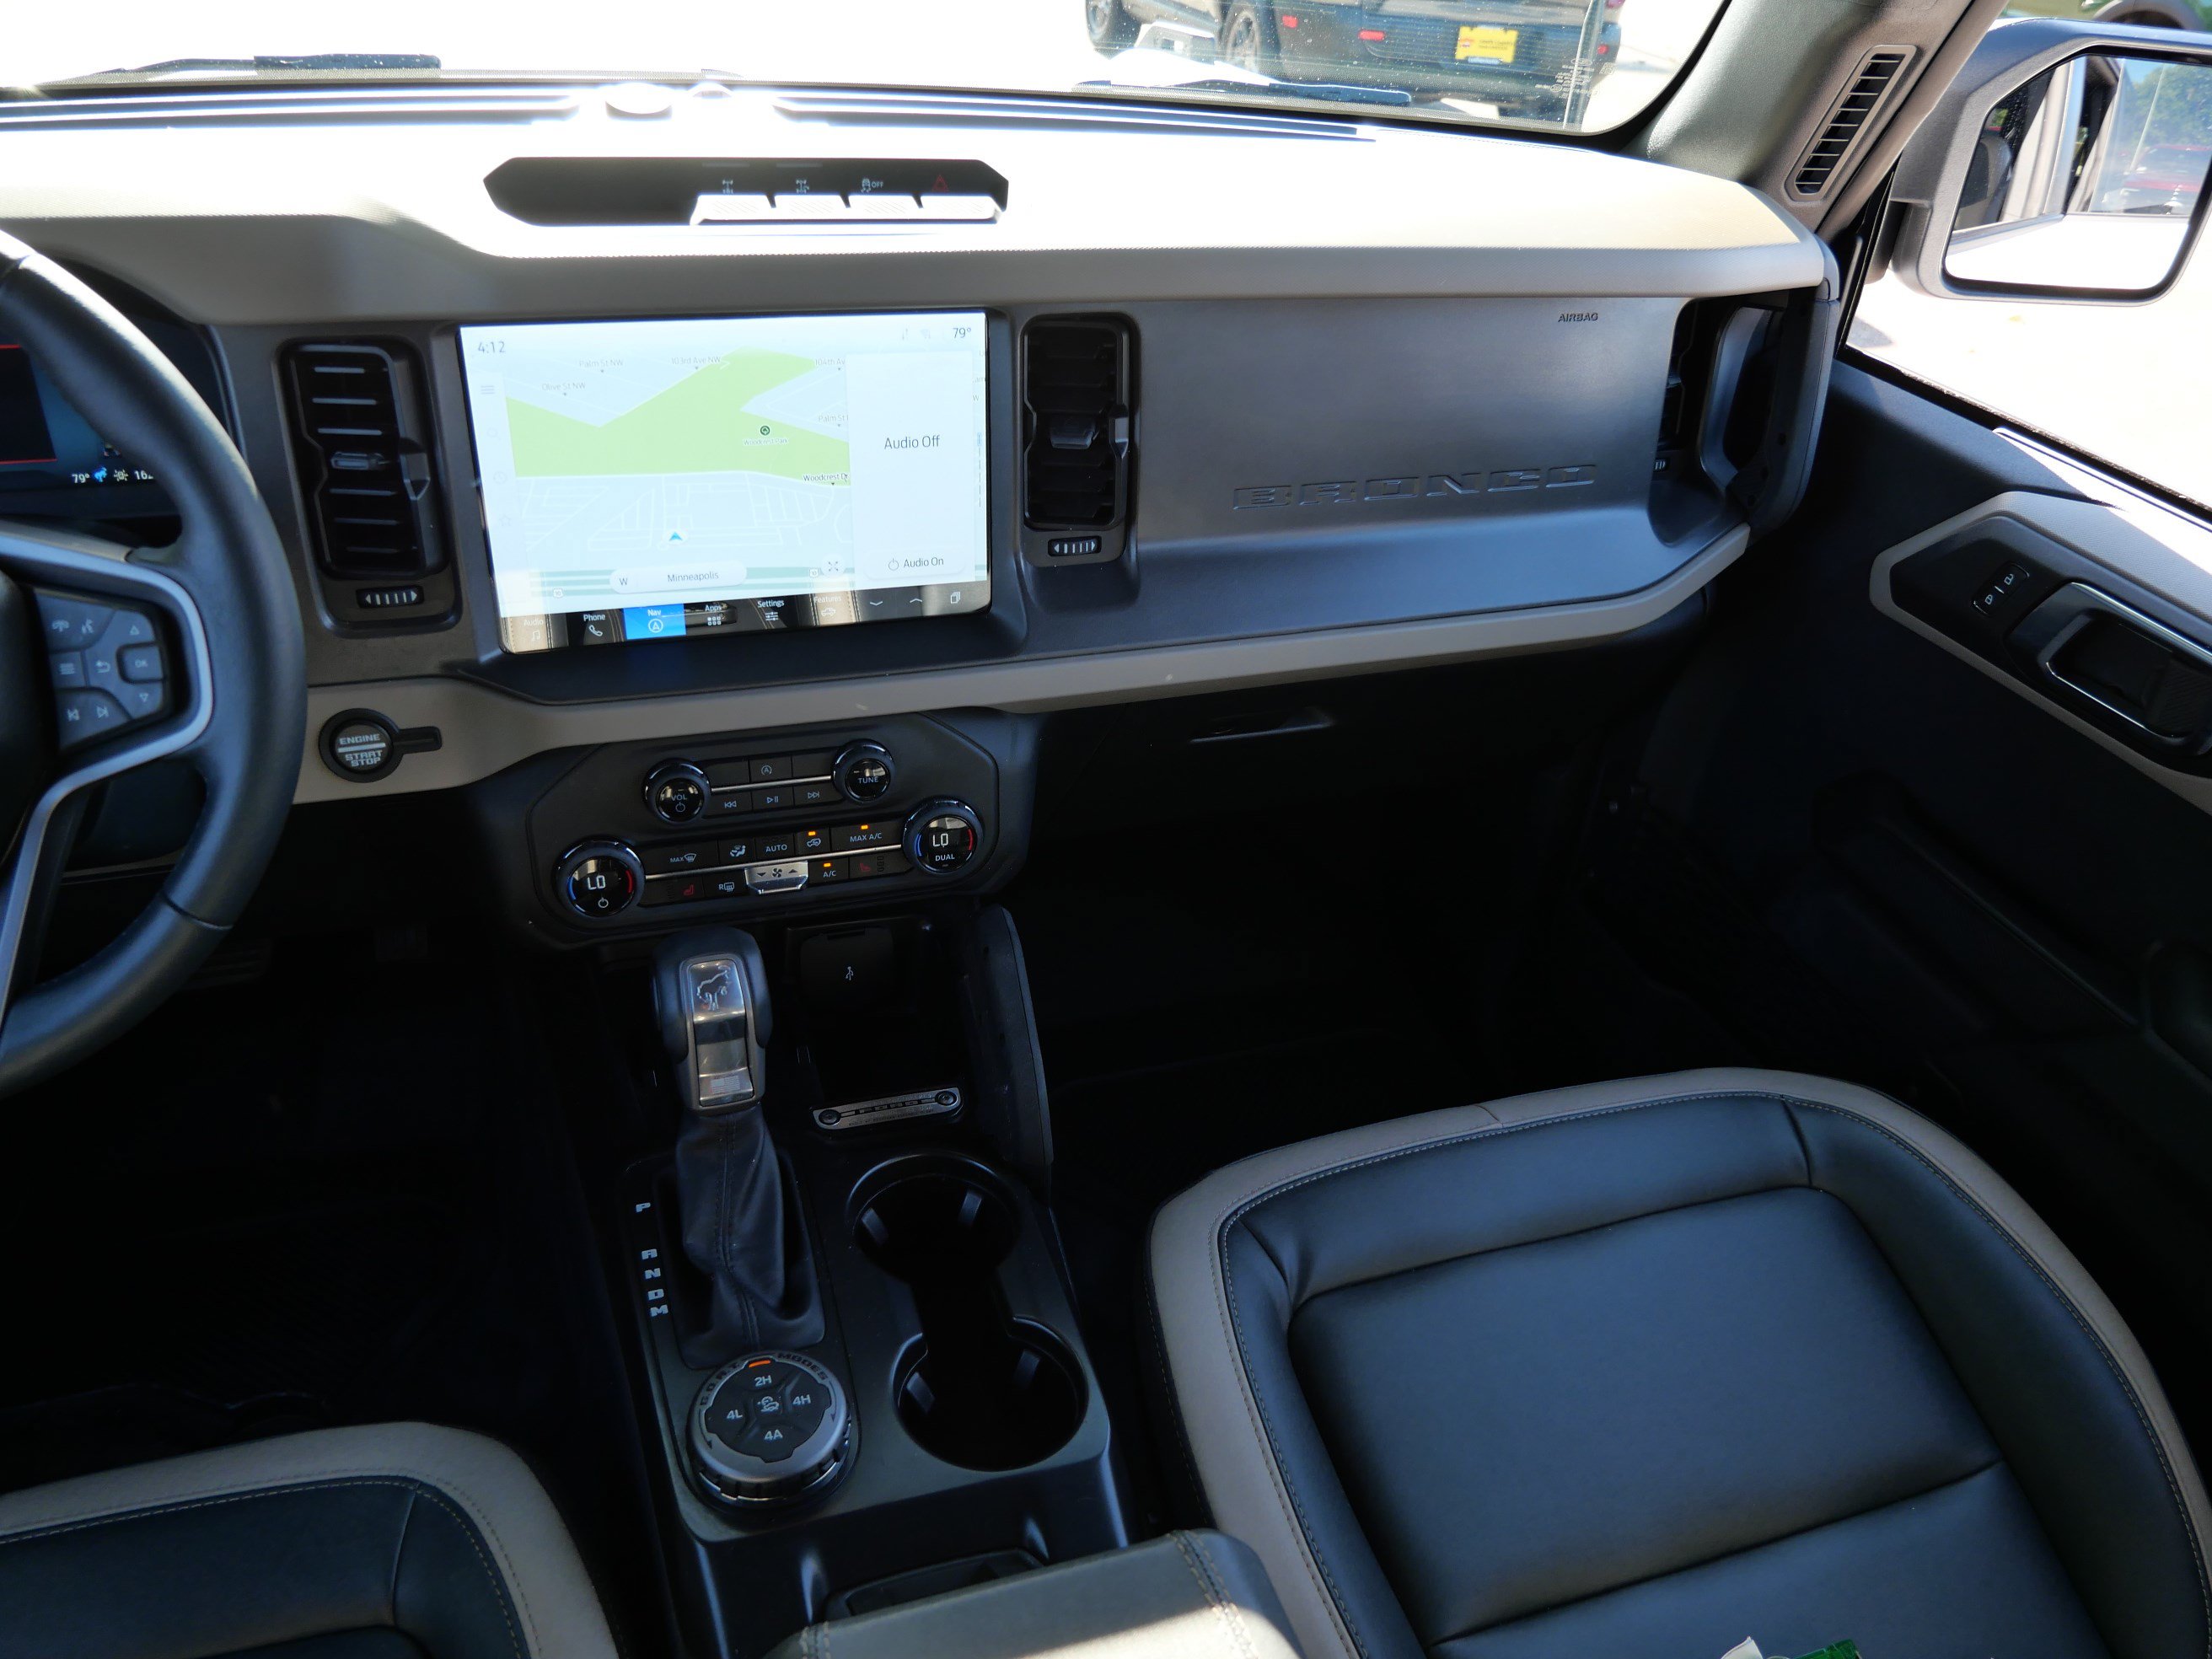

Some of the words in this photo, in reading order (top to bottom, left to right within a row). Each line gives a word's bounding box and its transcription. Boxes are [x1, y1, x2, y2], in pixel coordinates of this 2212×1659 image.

[1558, 312, 1598, 323] AIRBAG
[953, 327, 972, 339] 79°
[477, 341, 506, 354] 4:12
[578, 359, 599, 368] Palm
[601, 358, 609, 368] St
[609, 358, 624, 367] NW
[671, 357, 690, 365] 103rd
[541, 383, 561, 391] Olive
[571, 382, 586, 390] NW
[818, 414, 836, 422] Palm
[883, 436, 919, 449] Audio
[921, 434, 941, 448] Off
[71, 473, 90, 484] 79°
[803, 472, 840, 482] Woodcrest
[1232, 463, 1597, 511] BRONCO
[903, 556, 930, 568] Audio
[931, 556, 944, 566] On
[619, 577, 628, 586] W
[667, 571, 719, 583] Minneapolis
[757, 598, 785, 609] Settings
[813, 594, 842, 604] Features
[647, 608, 662, 617] Nav
[704, 604, 722, 613] Apps
[523, 618, 544, 626] Audio
[583, 612, 606, 622] Phone
[339, 733, 381, 745] ENGINE
[345, 749, 383, 761] START
[351, 756, 381, 767] STOP
[857, 776, 879, 785] TUNE
[849, 834, 867, 843] MAX
[869, 831, 883, 841] A/C
[932, 833, 949, 848] LO
[765, 843, 788, 853] AUTO
[935, 853, 955, 862] DUAL
[823, 869, 837, 879] A/C
[587, 874, 606, 890] LO
[636, 1201, 652, 1213] P
[644, 1267, 661, 1280] N
[647, 1288, 664, 1301] D
[650, 1304, 669, 1318] M
[777, 1352, 829, 1381] MODES
[754, 1374, 773, 1388] 2H
[792, 1393, 812, 1406] 4H
[726, 1409, 744, 1420] 4L
[763, 1429, 783, 1442] 4A
